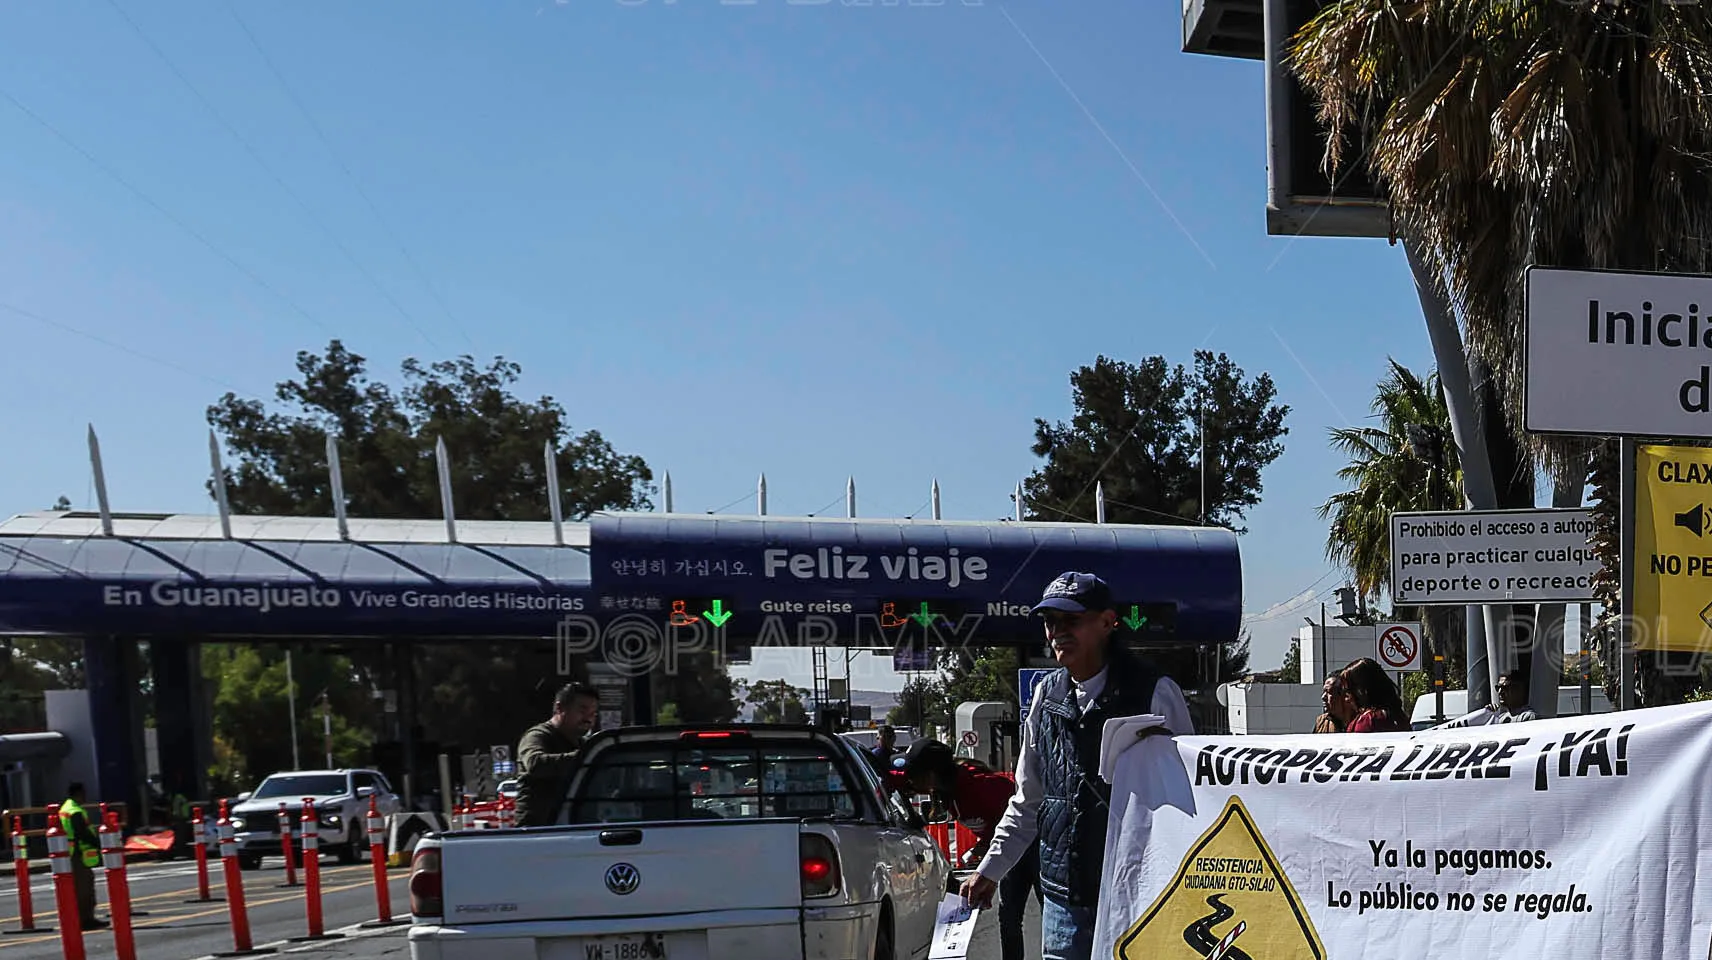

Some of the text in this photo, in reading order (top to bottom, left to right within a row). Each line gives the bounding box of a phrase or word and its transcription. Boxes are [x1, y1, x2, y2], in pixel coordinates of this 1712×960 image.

[1400, 521, 1465, 537] Prohibido
[1470, 520, 1481, 536] el
[1487, 522, 1535, 535] acceso
[1540, 522, 1548, 534] a
[612, 559, 752, 576] 안녕히 가십시오.
[765, 546, 987, 587] Feliz viaje
[1401, 553, 1440, 570] para
[1447, 547, 1528, 568] practicar
[1650, 555, 1681, 575] NO
[1402, 575, 1481, 595] deporte
[1489, 578, 1499, 589] o
[104, 586, 583, 612] En Guanajuato Vive Grandes Historias
[760, 600, 851, 612] Gute reise
[988, 601, 1030, 616] Nice
[1195, 728, 1629, 791] AUTOPISTA LIBRE ¡YA!
[1196, 858, 1263, 874] RESISTENCIA
[1369, 840, 1552, 875] Ya la pagamos.
[1185, 875, 1275, 892] CIUDADANA GTO-SILAO
[1328, 881, 1592, 920] Lo público no se regala.
